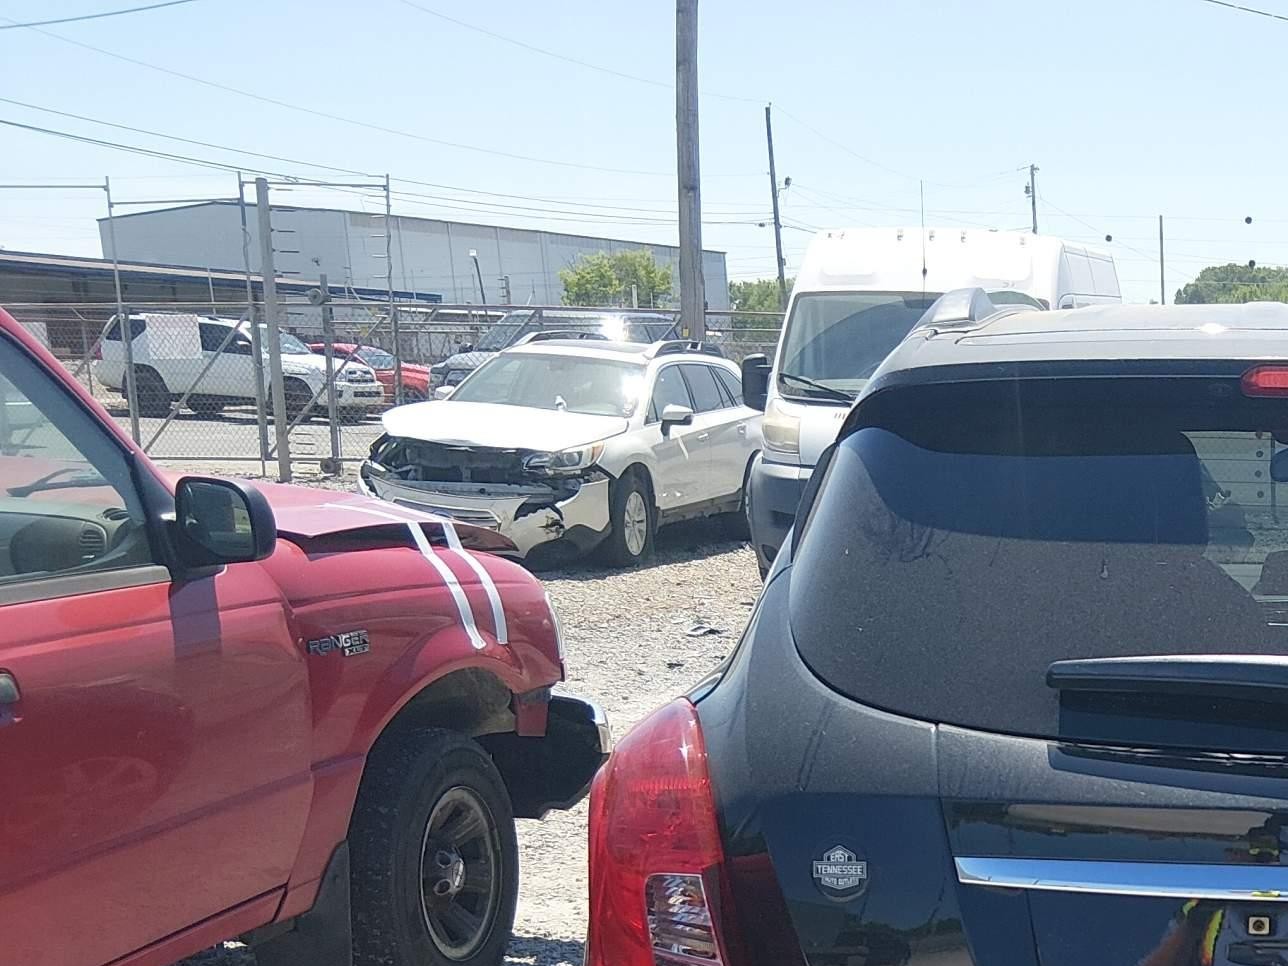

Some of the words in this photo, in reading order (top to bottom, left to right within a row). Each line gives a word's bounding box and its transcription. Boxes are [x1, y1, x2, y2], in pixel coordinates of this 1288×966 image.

[309, 630, 368, 656] RANGER
[830, 850, 849, 862] EAST
[816, 865, 863, 875] TENNESSEE
